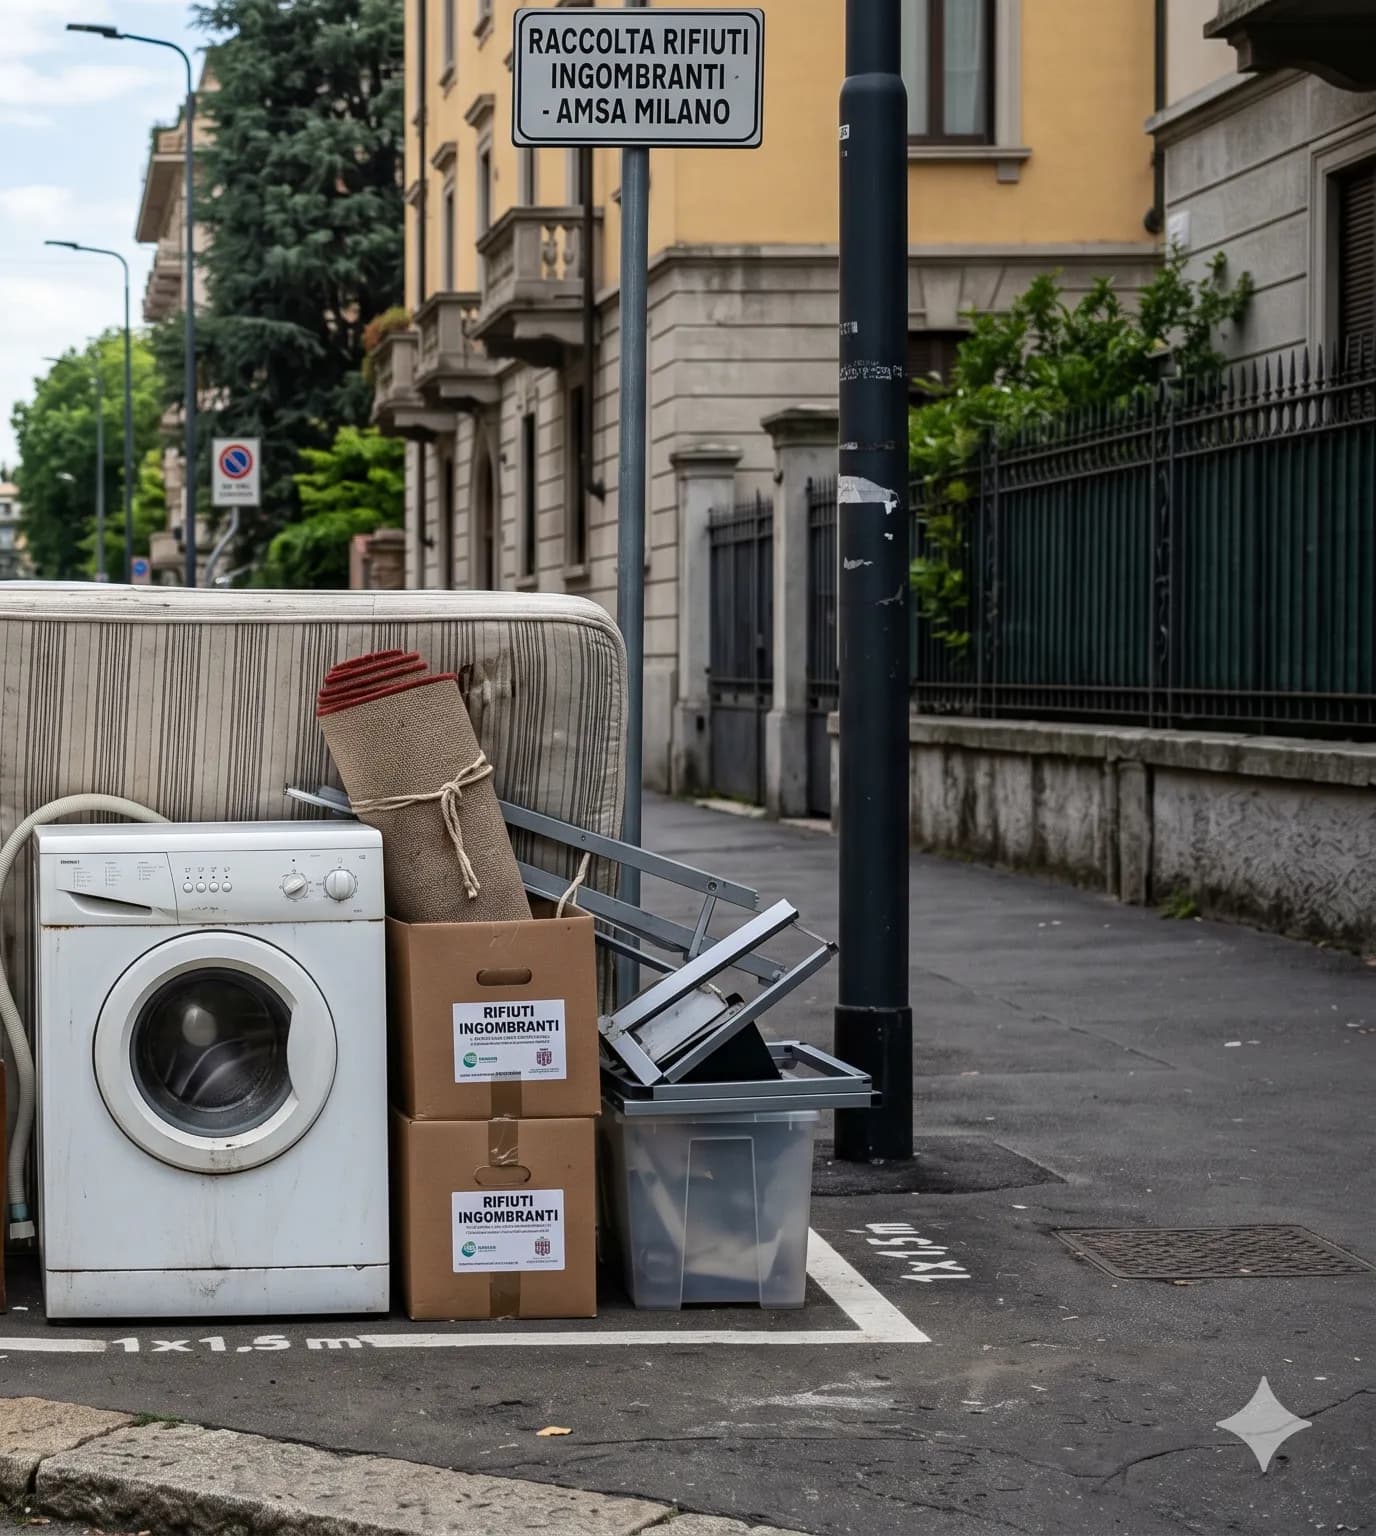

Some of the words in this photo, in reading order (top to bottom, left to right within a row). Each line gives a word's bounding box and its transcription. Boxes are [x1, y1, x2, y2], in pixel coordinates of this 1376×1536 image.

[529, 28, 656, 54] RACCOLTA
[663, 28, 749, 55] RIFIUTI
[551, 62, 725, 90] INGOMBRANTI
[556, 98, 627, 124] AMSA
[634, 98, 730, 125] MILANO
[483, 1004, 535, 1019] RIFIUTI
[459, 1019, 559, 1035] INGOMBRANTI
[483, 1194, 534, 1209] RIFIUTI
[458, 1209, 559, 1224] INGOMBRANTI
